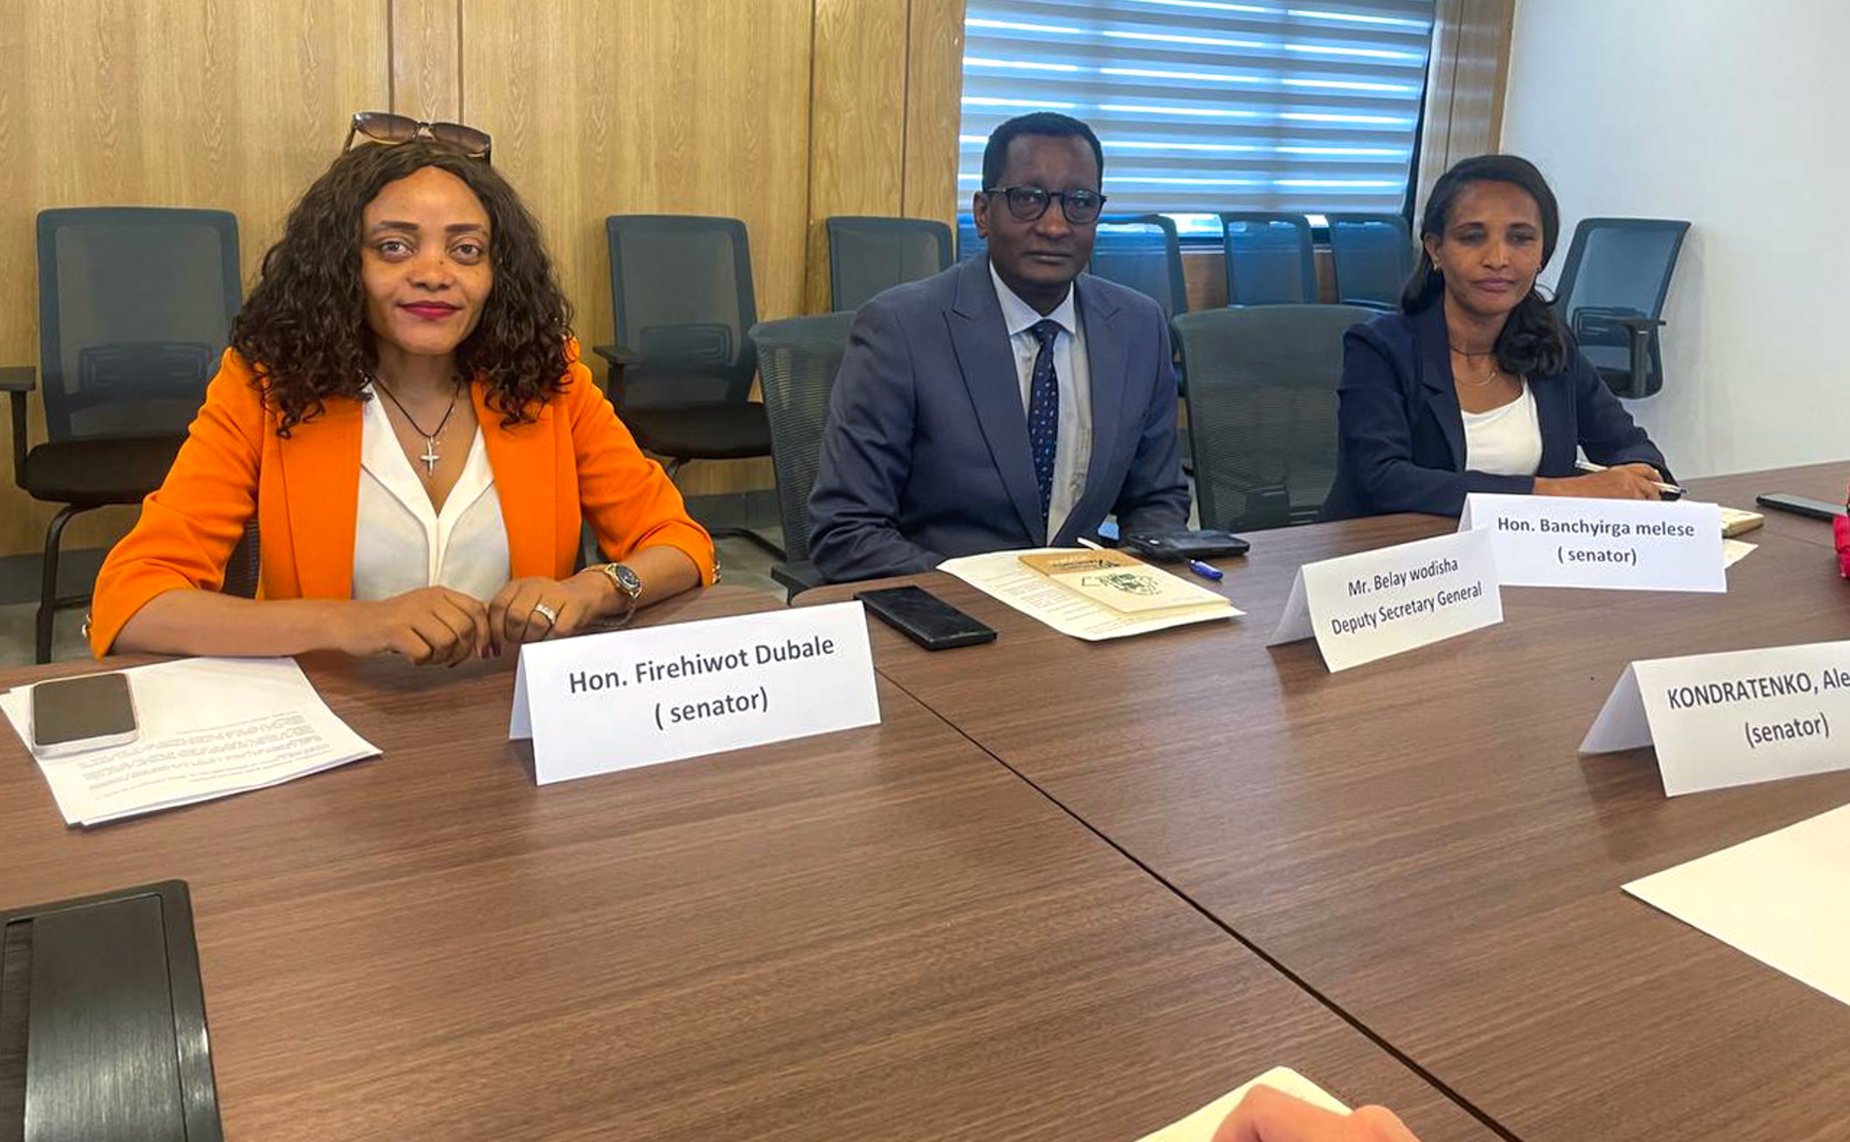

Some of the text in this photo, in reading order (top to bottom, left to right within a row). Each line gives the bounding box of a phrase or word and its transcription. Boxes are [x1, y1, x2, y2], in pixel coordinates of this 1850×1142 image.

[1497, 515, 1695, 537] Hon. Banchyirga melese
[1347, 557, 1459, 598] Mr. Belay wodisha
[1331, 581, 1482, 636] Deputy Secretary General
[568, 634, 835, 694] Hon. Firehiwot Dubale
[1667, 672, 1819, 709] KONDRATENKO,
[1745, 711, 1829, 748] (senator)
